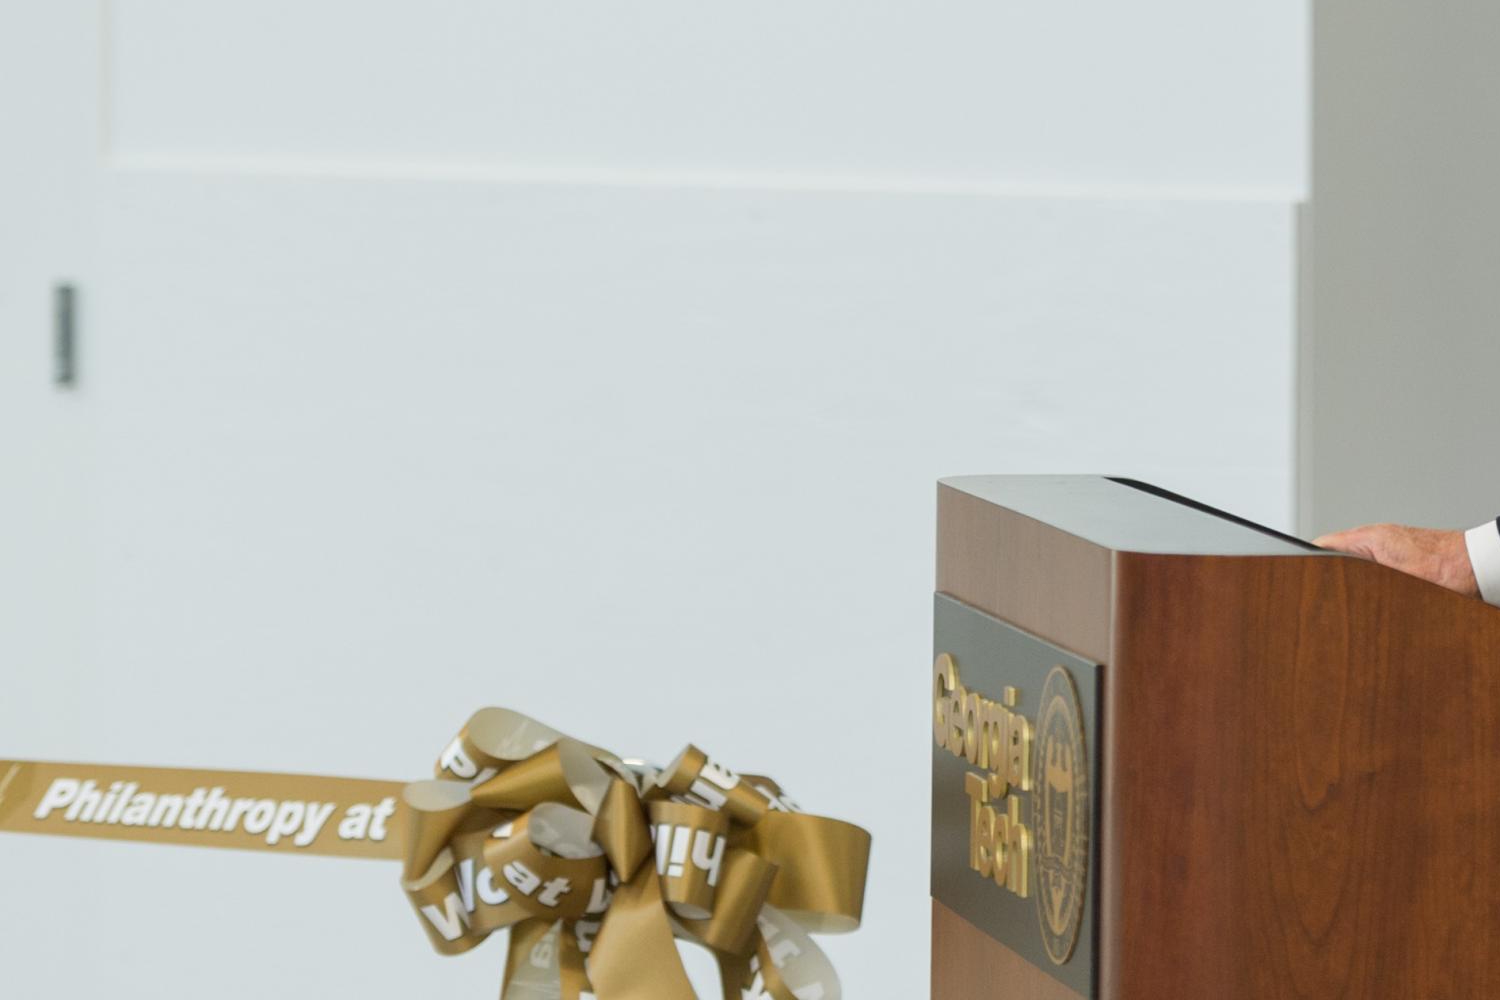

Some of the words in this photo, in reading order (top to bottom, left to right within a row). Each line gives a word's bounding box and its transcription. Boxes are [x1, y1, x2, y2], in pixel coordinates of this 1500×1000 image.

[934, 652, 1033, 798] Georgia
[33, 777, 335, 846] Philanthropy
[337, 796, 398, 841] at
[965, 771, 1033, 898] Tech
